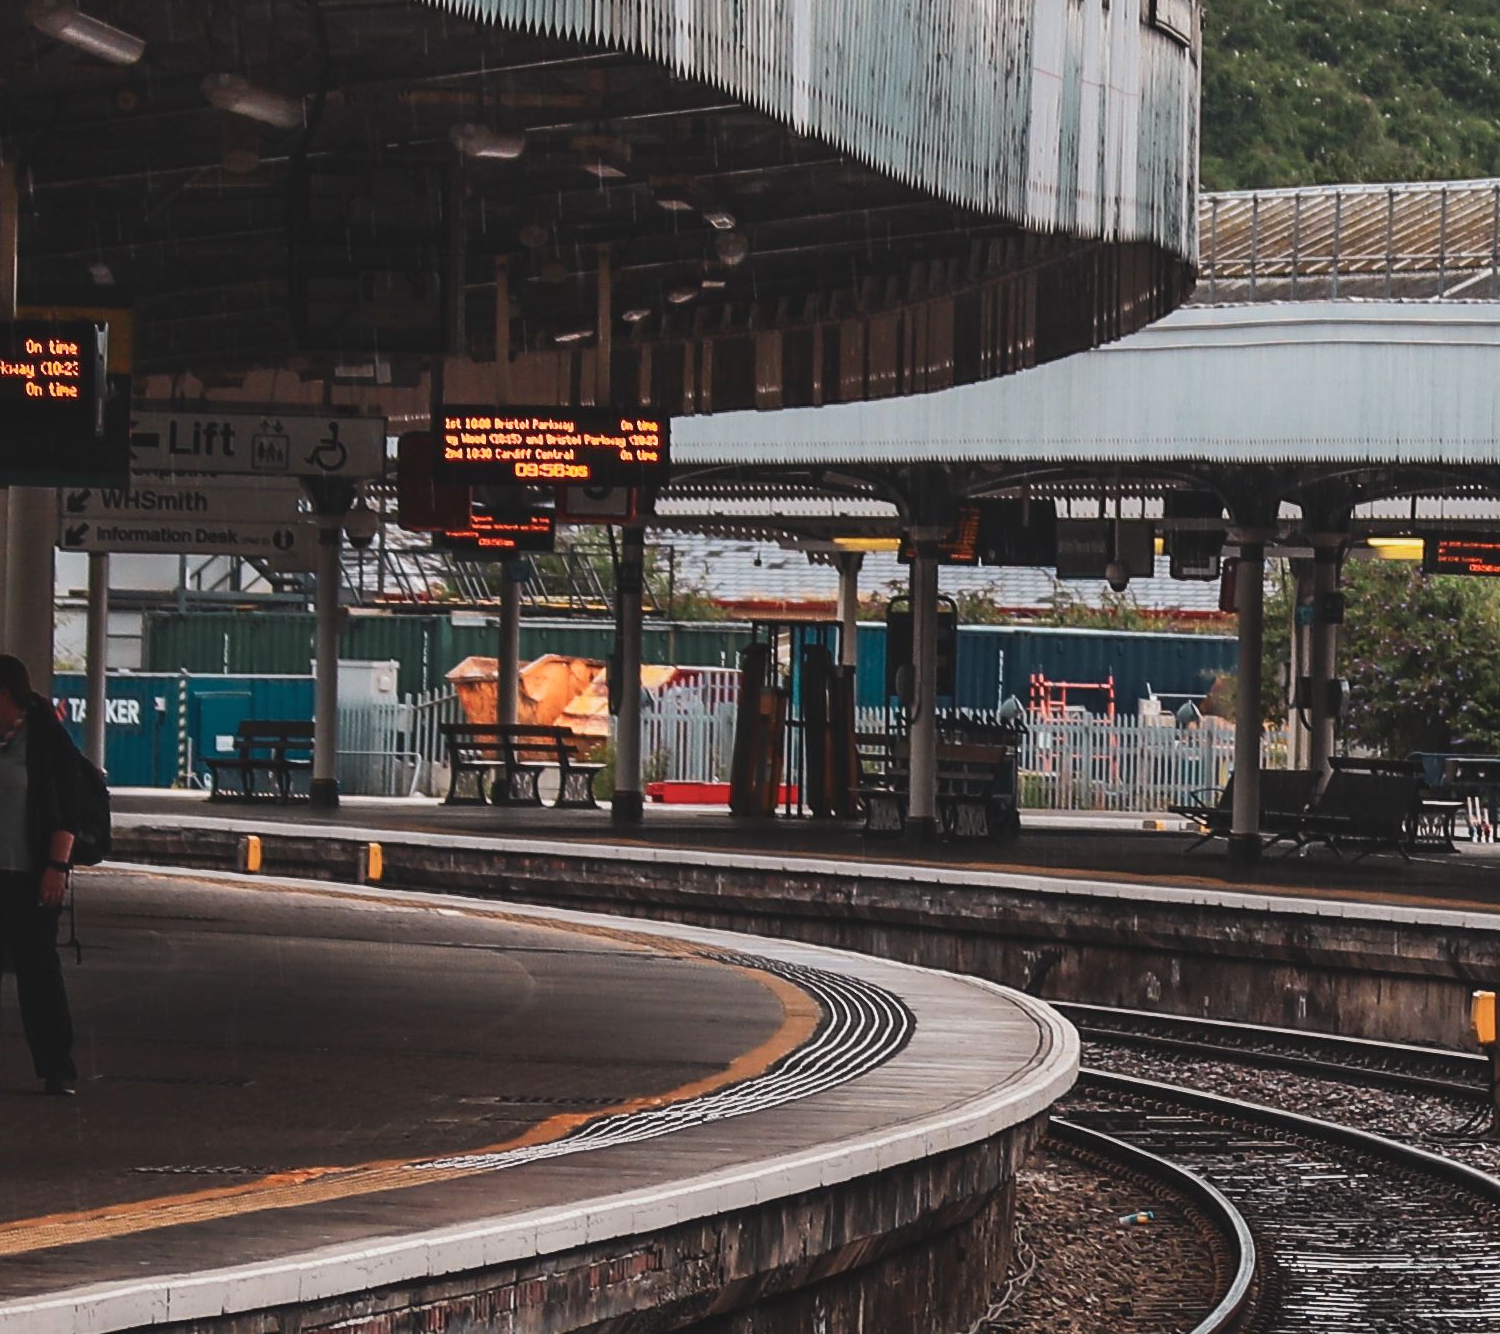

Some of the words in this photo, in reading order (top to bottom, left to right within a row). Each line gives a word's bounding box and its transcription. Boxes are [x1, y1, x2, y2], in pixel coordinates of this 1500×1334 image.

[25, 338, 43, 354] On
[48, 339, 78, 356] time
[25, 381, 43, 397] On
[48, 381, 78, 398] time
[493, 417, 530, 431] Bristol
[531, 418, 575, 433] Parkway
[620, 419, 634, 432] On
[636, 420, 659, 433] time
[169, 420, 235, 456] Lift
[525, 434, 545, 446] and
[545, 433, 583, 446] Bristol
[494, 448, 533, 460] Cardiff
[534, 448, 575, 461] Central
[619, 449, 634, 461] On
[636, 450, 659, 462] time
[101, 487, 208, 512] WHSmith
[97, 526, 192, 544] Information
[196, 528, 238, 544] Desk
[68, 697, 140, 724] TAKER
